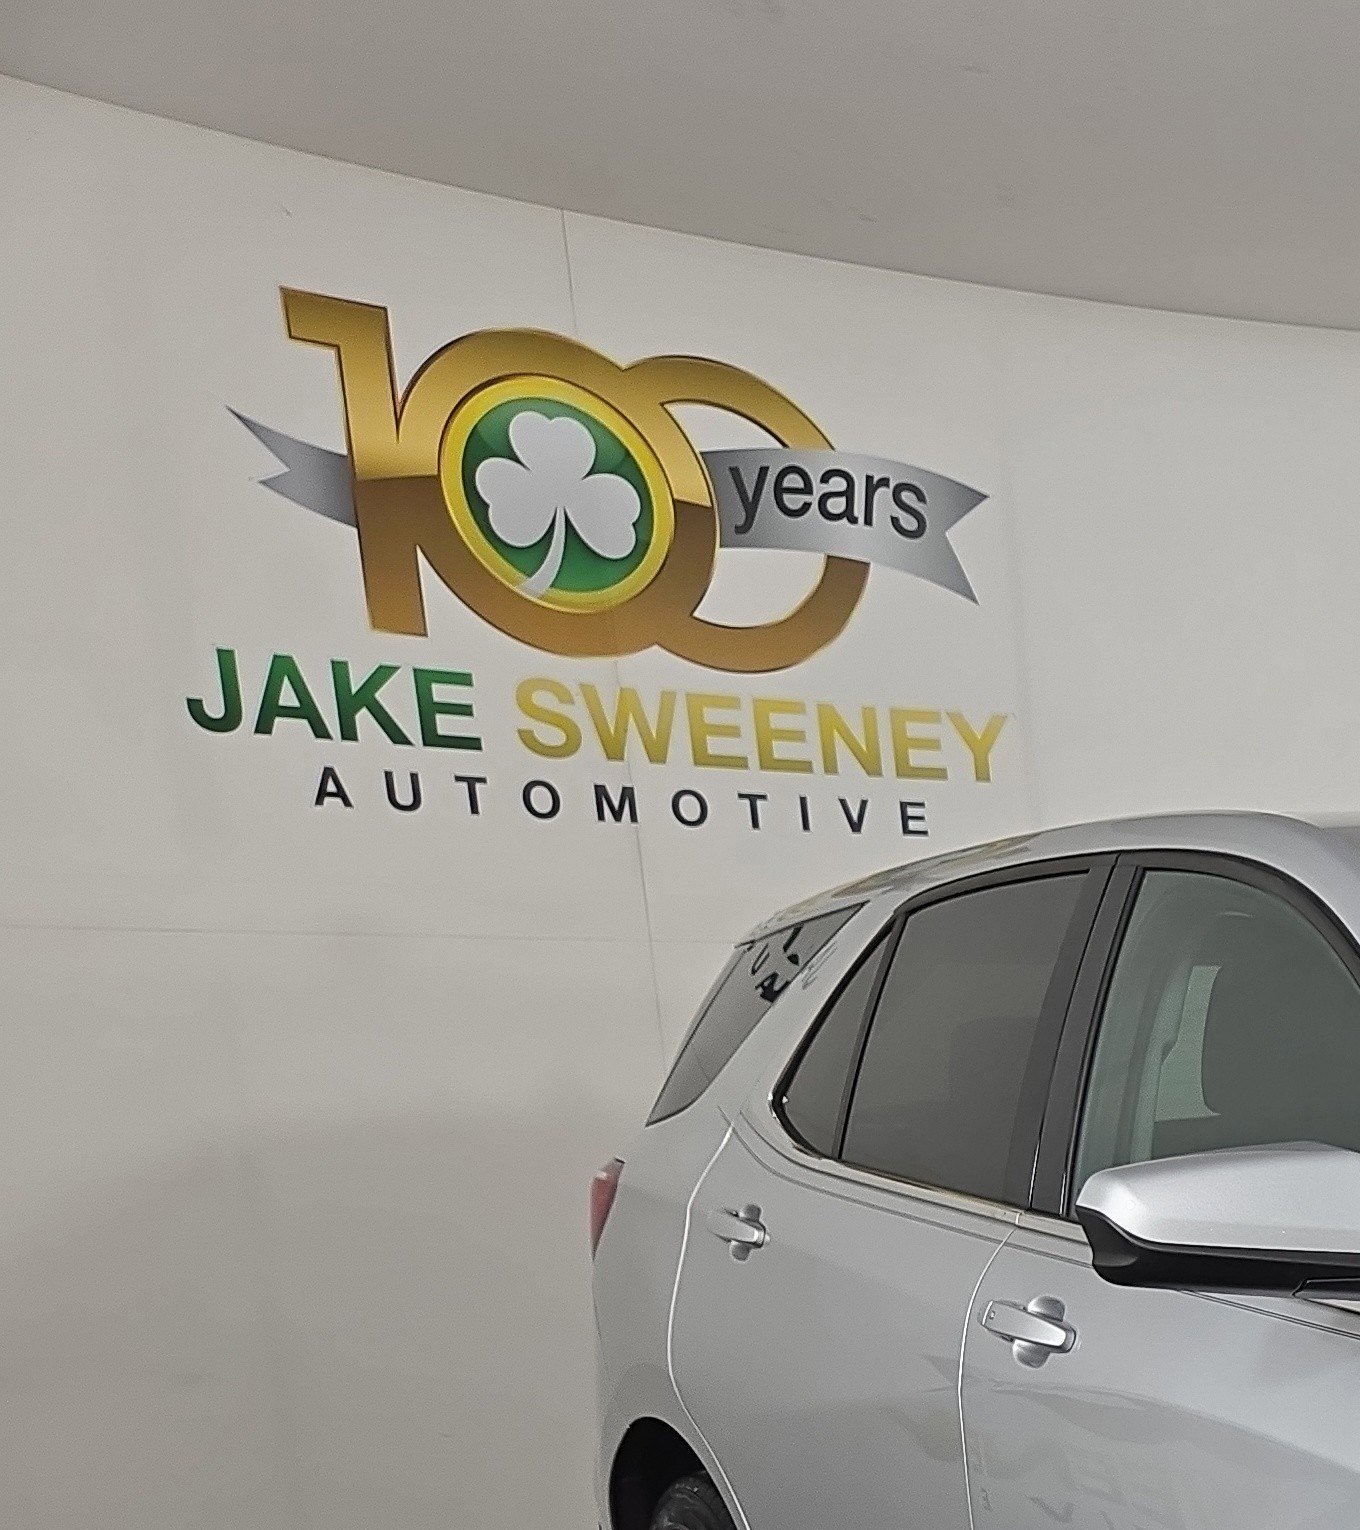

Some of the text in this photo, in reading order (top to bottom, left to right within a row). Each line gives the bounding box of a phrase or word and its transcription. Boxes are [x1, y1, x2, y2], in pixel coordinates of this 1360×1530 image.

[279, 286, 872, 674] 100
[727, 462, 928, 540] years
[186, 647, 1008, 782] JAKE SWEENEY
[314, 767, 929, 835] AUTOMOTIVE
